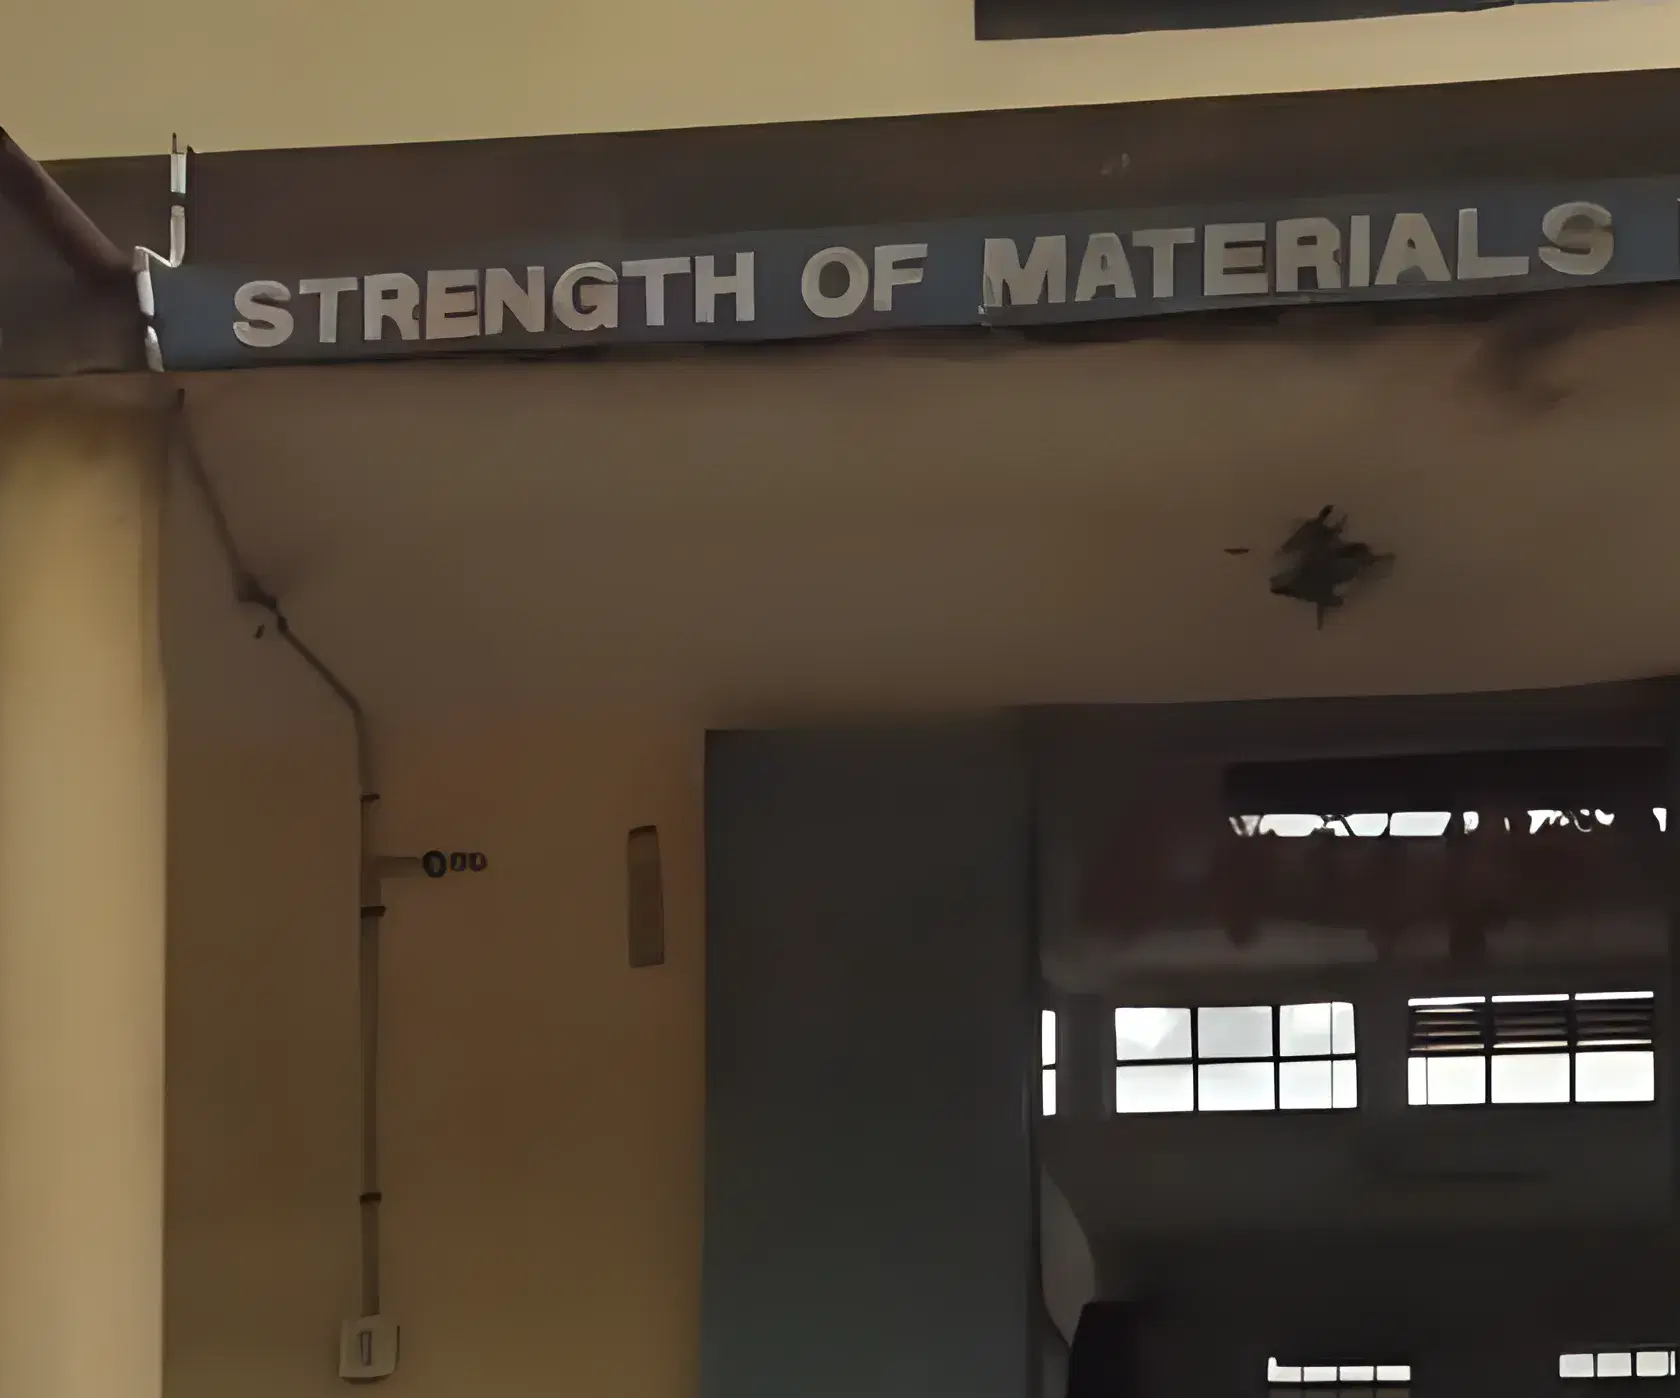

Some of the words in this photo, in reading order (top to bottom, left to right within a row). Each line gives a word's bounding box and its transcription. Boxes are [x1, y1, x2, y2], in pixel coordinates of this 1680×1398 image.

[232, 251, 755, 348] STRENGTH
[801, 243, 928, 319] OF
[983, 200, 1614, 307] MATERIALS
